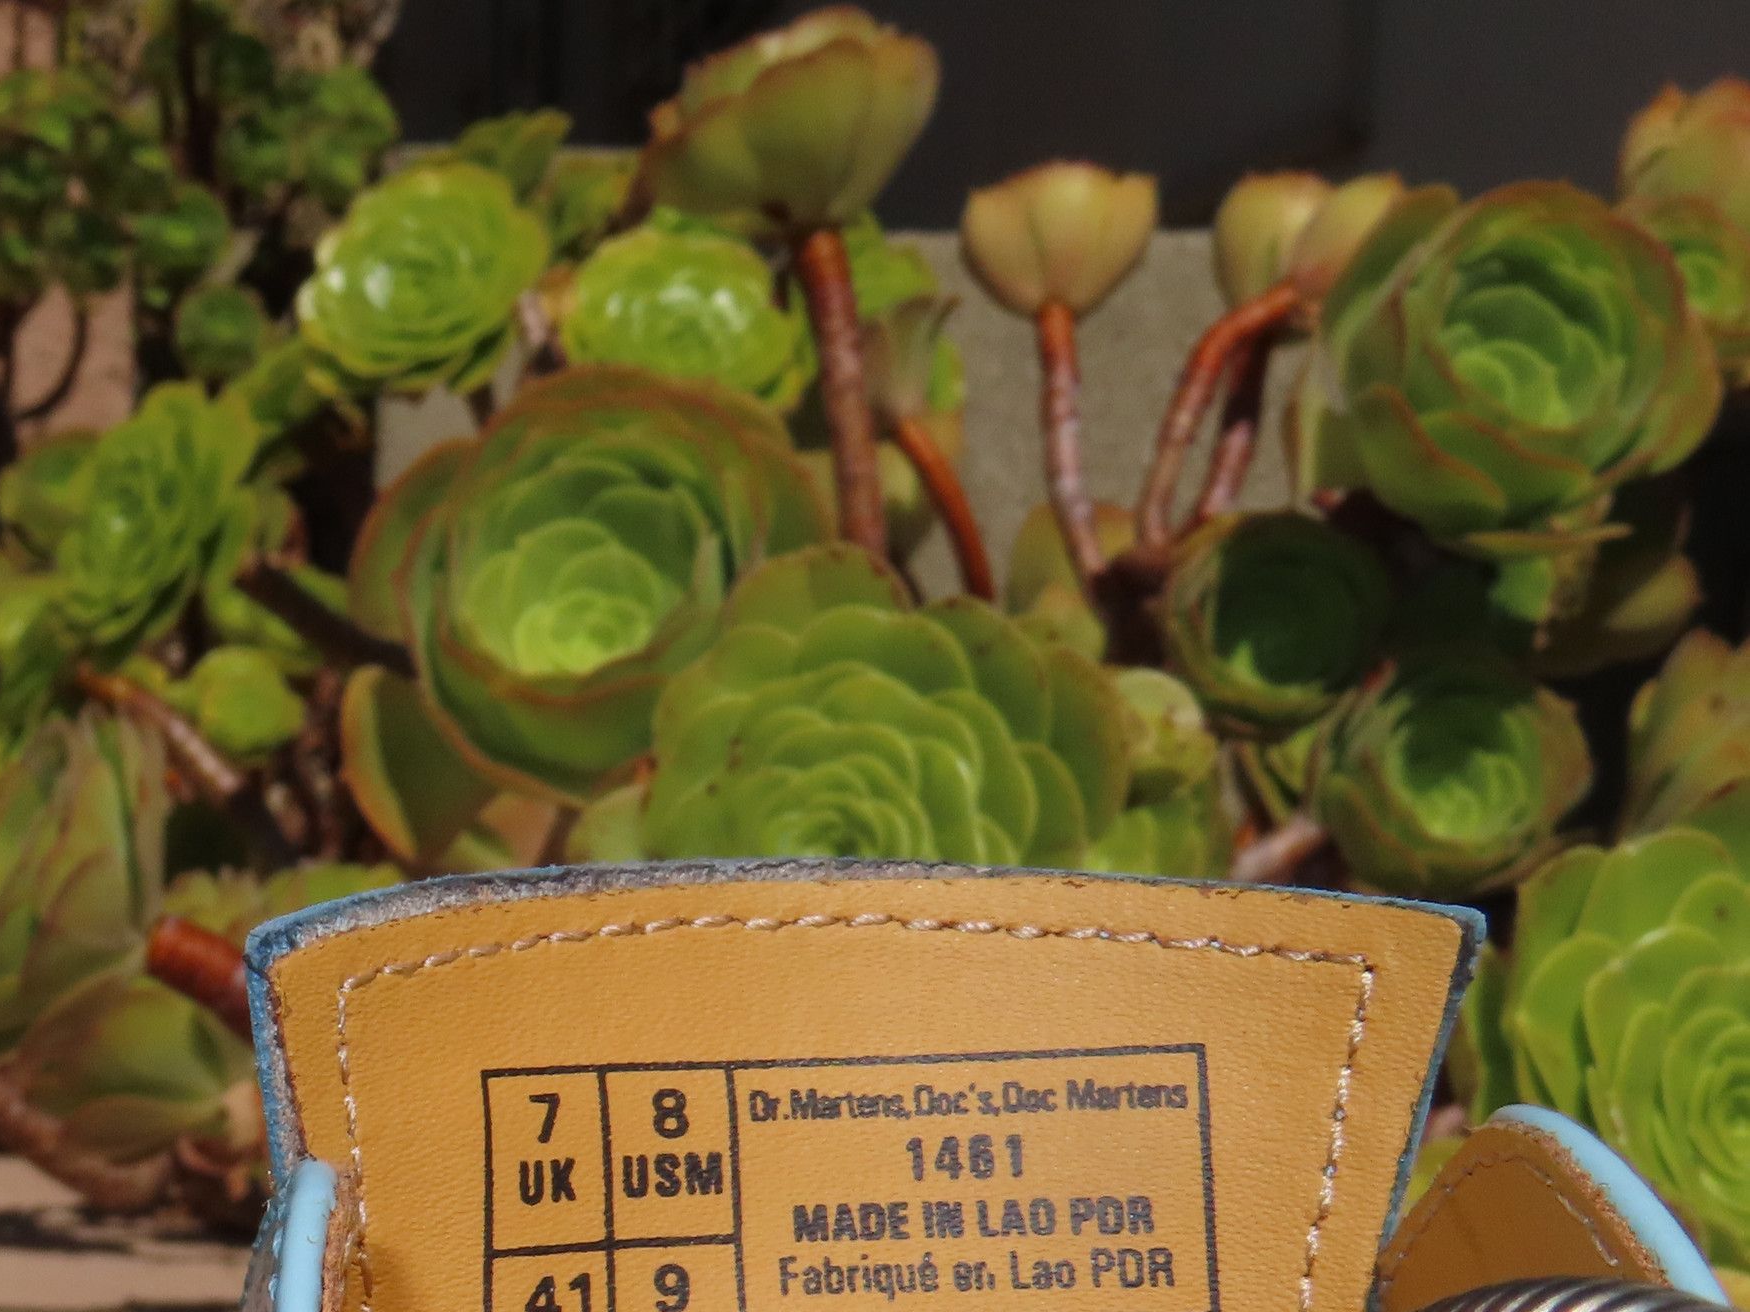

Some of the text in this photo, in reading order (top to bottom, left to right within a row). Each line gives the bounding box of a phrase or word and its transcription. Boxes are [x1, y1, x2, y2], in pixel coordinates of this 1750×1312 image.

[529, 1093, 560, 1143] 7
[652, 1088, 690, 1139] 8
[1066, 1078, 1188, 1111] Martens
[519, 1157, 576, 1206] UK
[622, 1152, 723, 1199] USM
[906, 1134, 1023, 1181] 1461
[793, 1196, 1155, 1242] MADE IN LAO PDR
[779, 1252, 939, 1301] Fabriqué
[1010, 1249, 1077, 1290] Lao
[1090, 1247, 1175, 1289] PDR
